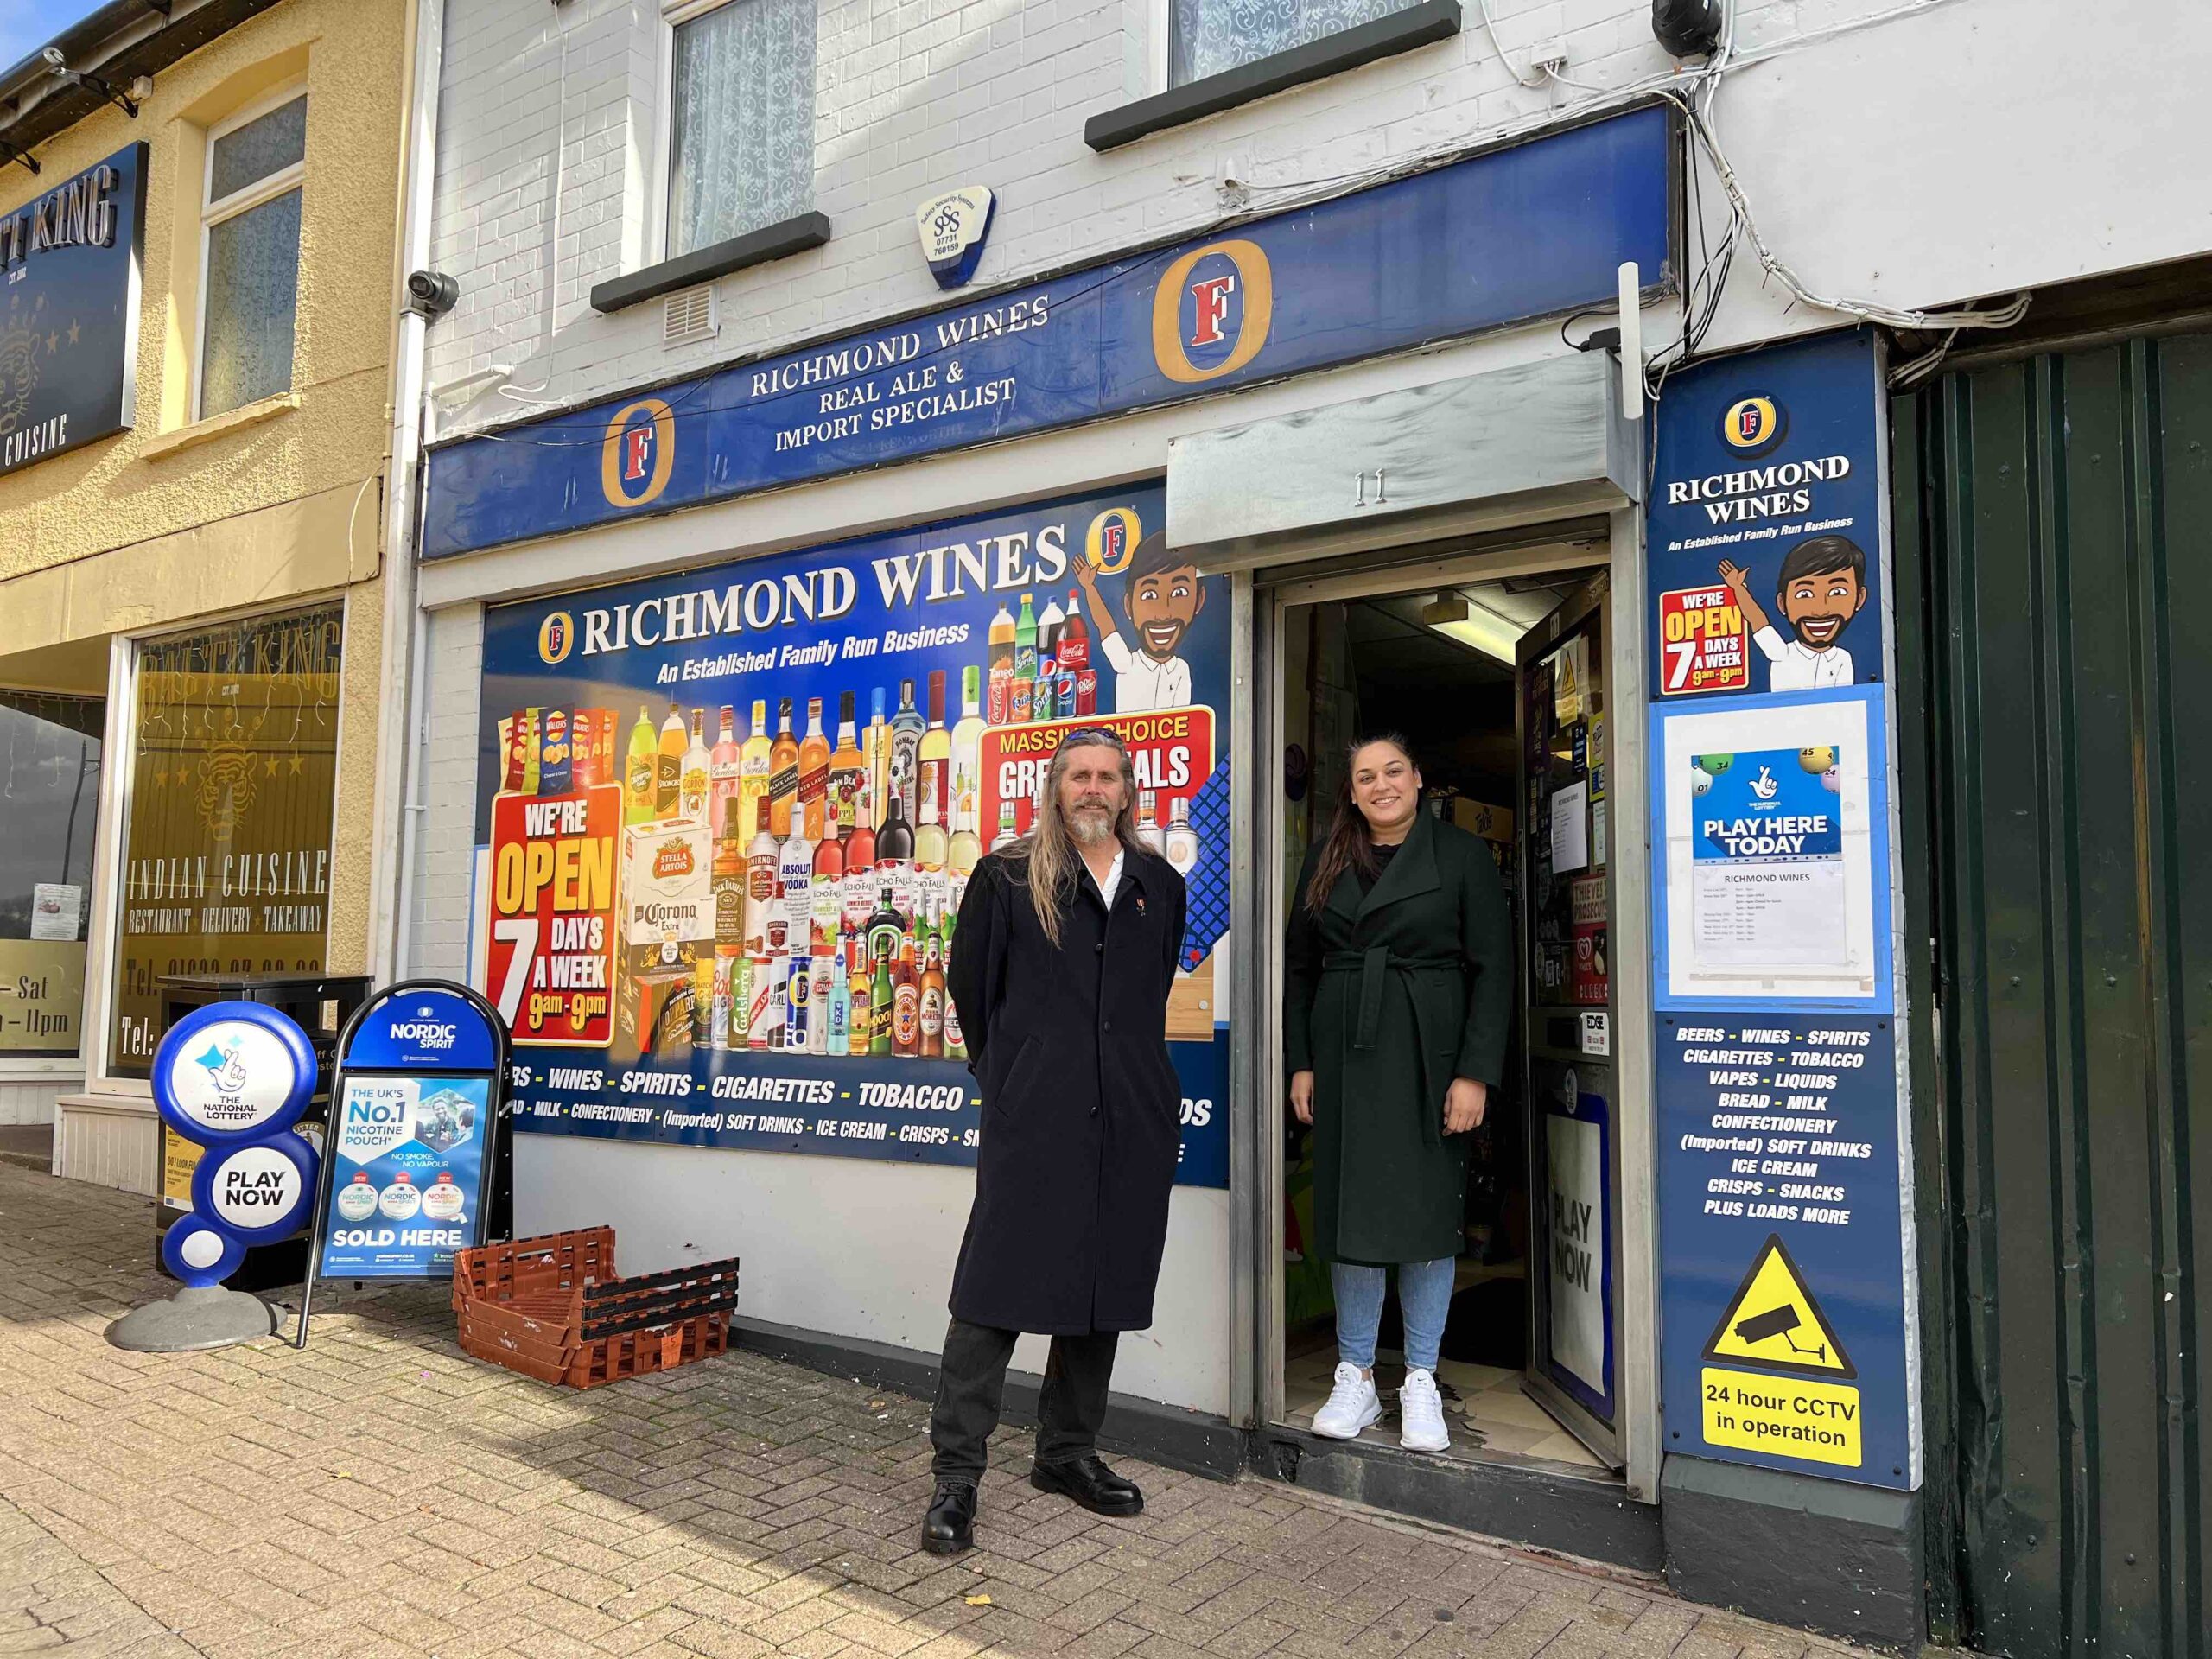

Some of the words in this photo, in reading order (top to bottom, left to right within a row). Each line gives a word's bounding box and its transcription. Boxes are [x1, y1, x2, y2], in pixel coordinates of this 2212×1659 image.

[30, 164, 111, 251] KING
[921, 207, 936, 225] Safety
[935, 195, 957, 209] Security
[957, 194, 976, 210] Systems
[934, 243, 959, 256] 760159
[936, 233, 957, 246] 07731
[750, 332, 920, 397] RICHMOND
[934, 294, 1052, 346] WINES
[818, 384, 880, 413] REAL
[888, 366, 937, 397] ALE
[946, 360, 964, 382] &
[774, 413, 864, 451] IMPORT
[869, 377, 1016, 430] SPECIALIST
[5, 413, 67, 467] CUISINE
[1354, 467, 1387, 507] 11
[1667, 455, 1850, 505] RICHMOND
[1703, 488, 1811, 525] WINES
[1667, 541, 1681, 552] An
[1683, 531, 1741, 550] Established
[1744, 527, 1778, 542] Family
[1780, 524, 1802, 536] Run
[1803, 517, 1853, 533] Business
[581, 565, 856, 657] RICHMOND
[871, 524, 1068, 609] WINES
[1681, 591, 1724, 610] WE'RE
[1665, 605, 1743, 642] OPEN
[656, 663, 678, 685] An
[682, 647, 777, 681] Established
[779, 639, 838, 668] Family
[840, 636, 878, 660] Run
[881, 623, 970, 654] Business
[1704, 636, 1738, 654] DAYS
[254, 620, 340, 698] KING
[1015, 654, 1035, 670] Sprite
[1666, 641, 1697, 689] 7
[1694, 655, 1704, 671] A
[1705, 652, 1742, 669] WEEK
[988, 667, 1014, 680] Tango
[894, 736, 915, 747] BOMBAY
[1801, 747, 1815, 758] 45
[1716, 760, 1729, 770] 34
[1824, 768, 1837, 777] 24
[769, 780, 784, 791] BLACK
[784, 772, 798, 784] LABEL
[799, 783, 810, 792] RED
[810, 773, 828, 785] LABEL
[1697, 783, 1708, 793] 01
[524, 799, 588, 836] WE'RE
[1703, 818, 1763, 837] PLAY
[1765, 815, 1827, 835] HERE
[1724, 835, 1807, 855] TODAY
[660, 852, 687, 863] STELLA
[660, 861, 687, 872] ARTOIS
[129, 855, 207, 900] INDIAN
[222, 849, 327, 898] CUISINE
[496, 836, 613, 914] OPEN
[781, 863, 811, 875] ABSOLUT
[1724, 874, 1777, 883] RICHMOND
[1778, 873, 1810, 882] WINES
[784, 878, 809, 890] VODKA
[844, 882, 861, 892] ECHO
[876, 876, 894, 887] ECHO
[893, 875, 912, 886] FALLS
[928, 879, 945, 889] FALLS
[1573, 881, 1603, 903] THIEVES
[129, 908, 191, 934] RESTAURANT
[201, 906, 252, 933] DELIVERY
[264, 906, 323, 932] TAKEAWAY
[645, 902, 697, 927] Corona
[551, 917, 604, 950] DAYS
[661, 921, 680, 931] Extra
[494, 918, 539, 1029] 7
[533, 956, 547, 988] A
[550, 955, 607, 988] WEEK
[18, 976, 49, 1000] Sat
[733, 969, 751, 1035] Carlsberg
[26, 1008, 68, 1037] 11pm
[390, 1023, 457, 1040] NORDIC
[122, 1016, 154, 1056] Tel:
[419, 1039, 454, 1049] SPIRIT
[1676, 1027, 1726, 1044] BEERS
[1741, 1028, 1791, 1045] WINES
[1807, 1030, 1872, 1047] SPIRITS
[1683, 1049, 1774, 1066] CIGARETTES
[1790, 1052, 1865, 1069] TOBACCO
[548, 1067, 604, 1092] WINES
[620, 1071, 693, 1097] SPIRITS
[711, 1075, 836, 1105] CIGARETTES
[858, 1082, 964, 1112] TOBACCO
[1709, 1071, 1758, 1087] VAPES
[1774, 1072, 1838, 1090] LIQUIDS
[219, 1096, 241, 1104] THE
[351, 1089, 374, 1098] THE
[377, 1089, 404, 1098] UK'S
[1718, 1092, 1770, 1109] BREAD
[1786, 1095, 1829, 1112] MILK
[203, 1103, 257, 1113] NATIONAL
[348, 1100, 406, 1123] No.1
[346, 1125, 404, 1135] NICOTINE
[534, 1101, 563, 1117] MILK
[570, 1103, 654, 1124] CONFECTIONERY
[663, 1109, 724, 1133] (Imported)
[726, 1113, 757, 1131] SOFT
[757, 1115, 804, 1135] DRINKS
[816, 1118, 837, 1137] ICE
[840, 1119, 887, 1141] CREAM
[899, 1123, 950, 1146] CRISPS
[1711, 1114, 1838, 1135] CONFECTIONERY
[1681, 1134, 1764, 1155] (Imported)
[1767, 1138, 1808, 1155] SOFT
[1809, 1141, 1872, 1159] DRINKS
[1731, 1158, 1758, 1174] ICE
[1761, 1160, 1819, 1178] CREAM
[226, 1171, 286, 1188] PLAY
[225, 1189, 284, 1206] NOW
[342, 1193, 375, 1202] NORDIC
[384, 1192, 416, 1201] NORDIC
[1707, 1178, 1764, 1196] CRISPS
[1779, 1183, 1846, 1202] SNACKS
[1554, 1192, 1592, 1244] PLAY
[1703, 1199, 1744, 1217] PLUS
[1747, 1203, 1799, 1221] LOADS
[1802, 1207, 1851, 1225] MORE
[332, 1229, 396, 1247] SOLD
[400, 1230, 463, 1247] HERE
[1554, 1236, 1592, 1294] NOW
[1706, 1384, 1730, 1403] 24
[1737, 1388, 1787, 1411] hour
[1793, 1396, 1856, 1421] CCTV
[1717, 1411, 1735, 1430] in
[1742, 1419, 1847, 1447] operation
